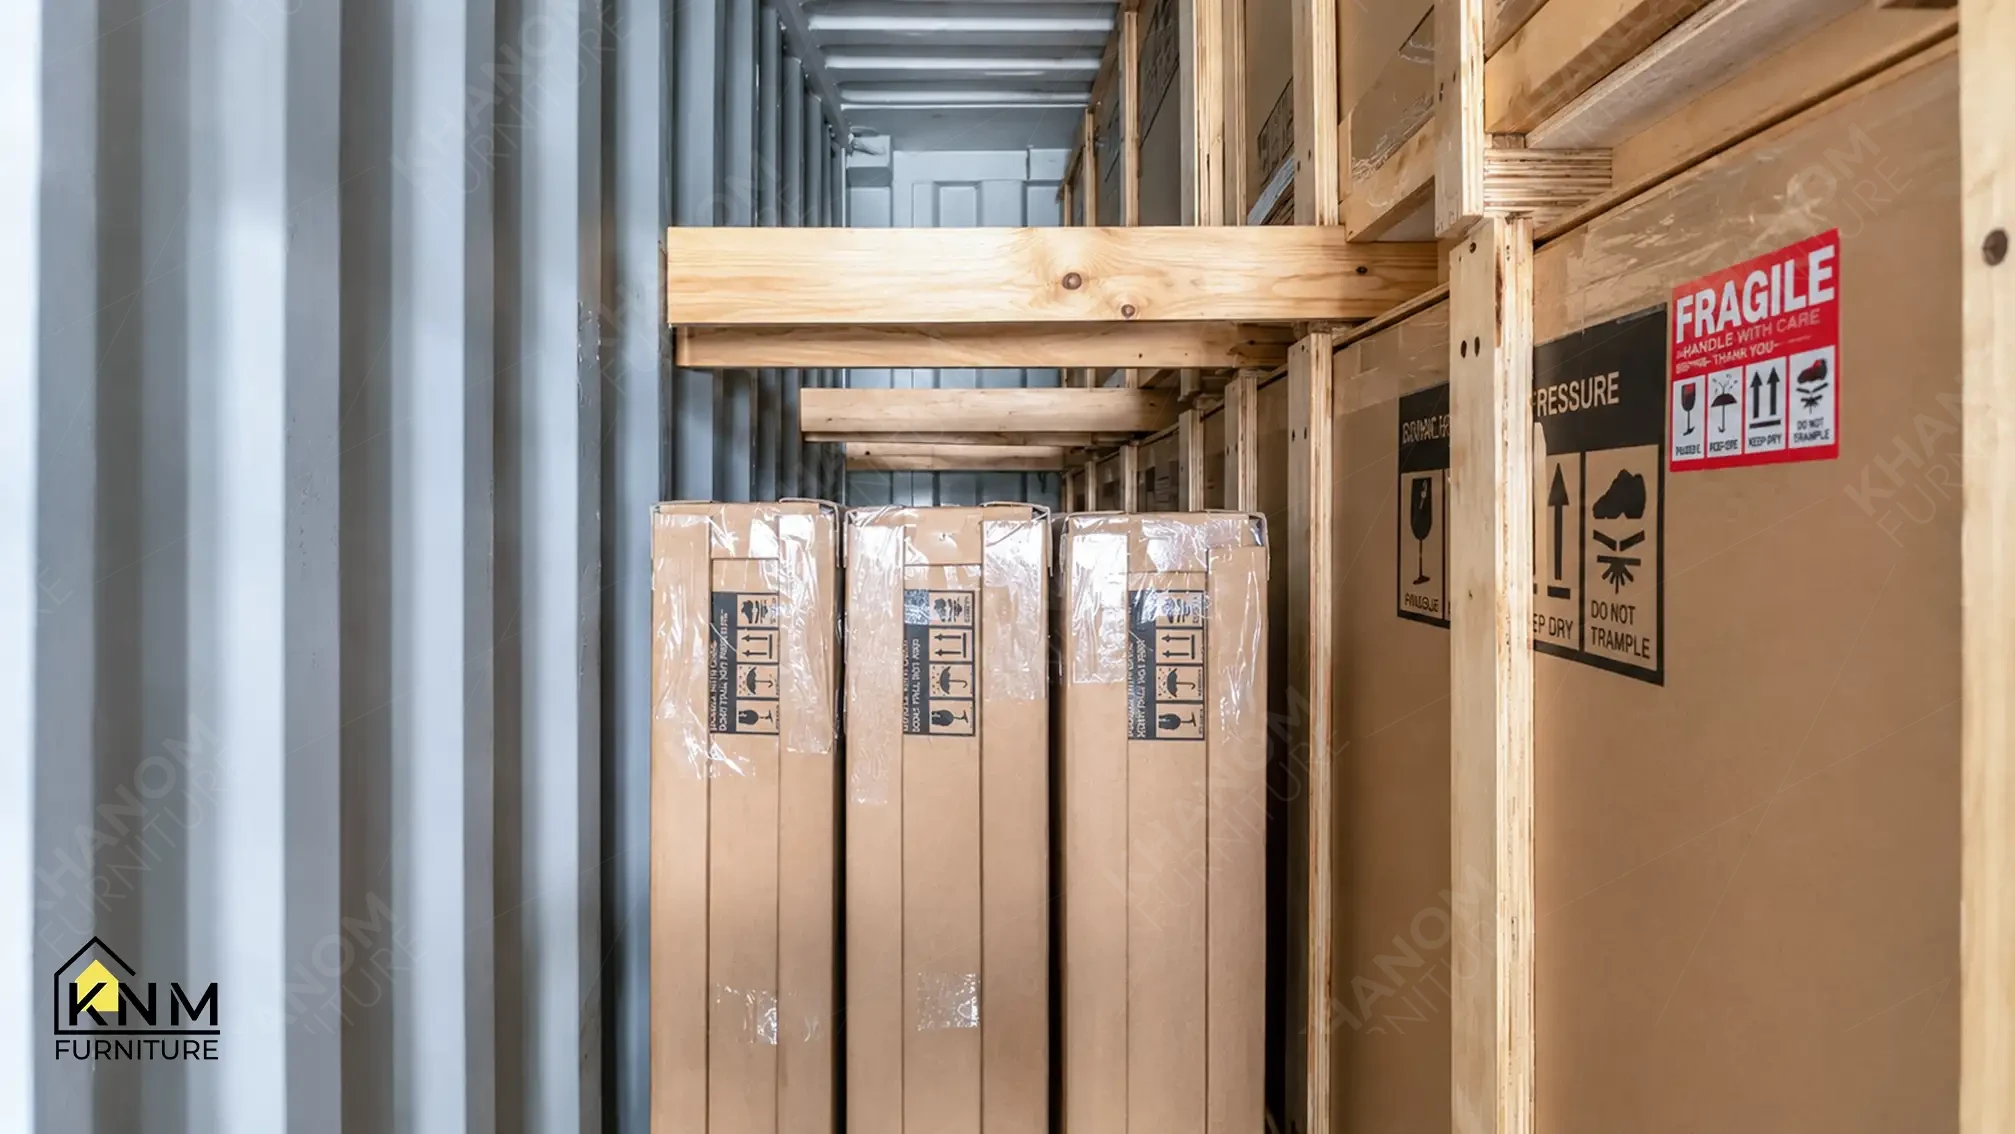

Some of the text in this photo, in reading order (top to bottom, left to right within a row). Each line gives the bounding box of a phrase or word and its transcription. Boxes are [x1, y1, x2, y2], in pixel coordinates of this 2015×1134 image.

[1676, 244, 1835, 345] FRAGILE
[1737, 321, 1773, 343] WITH
[1776, 308, 1821, 333] CARE
[1533, 371, 1620, 417] RESSURE
[1548, 616, 1574, 640] DRY
[1591, 600, 1636, 626] DO NOT
[1591, 626, 1651, 660] TRAMPLE
